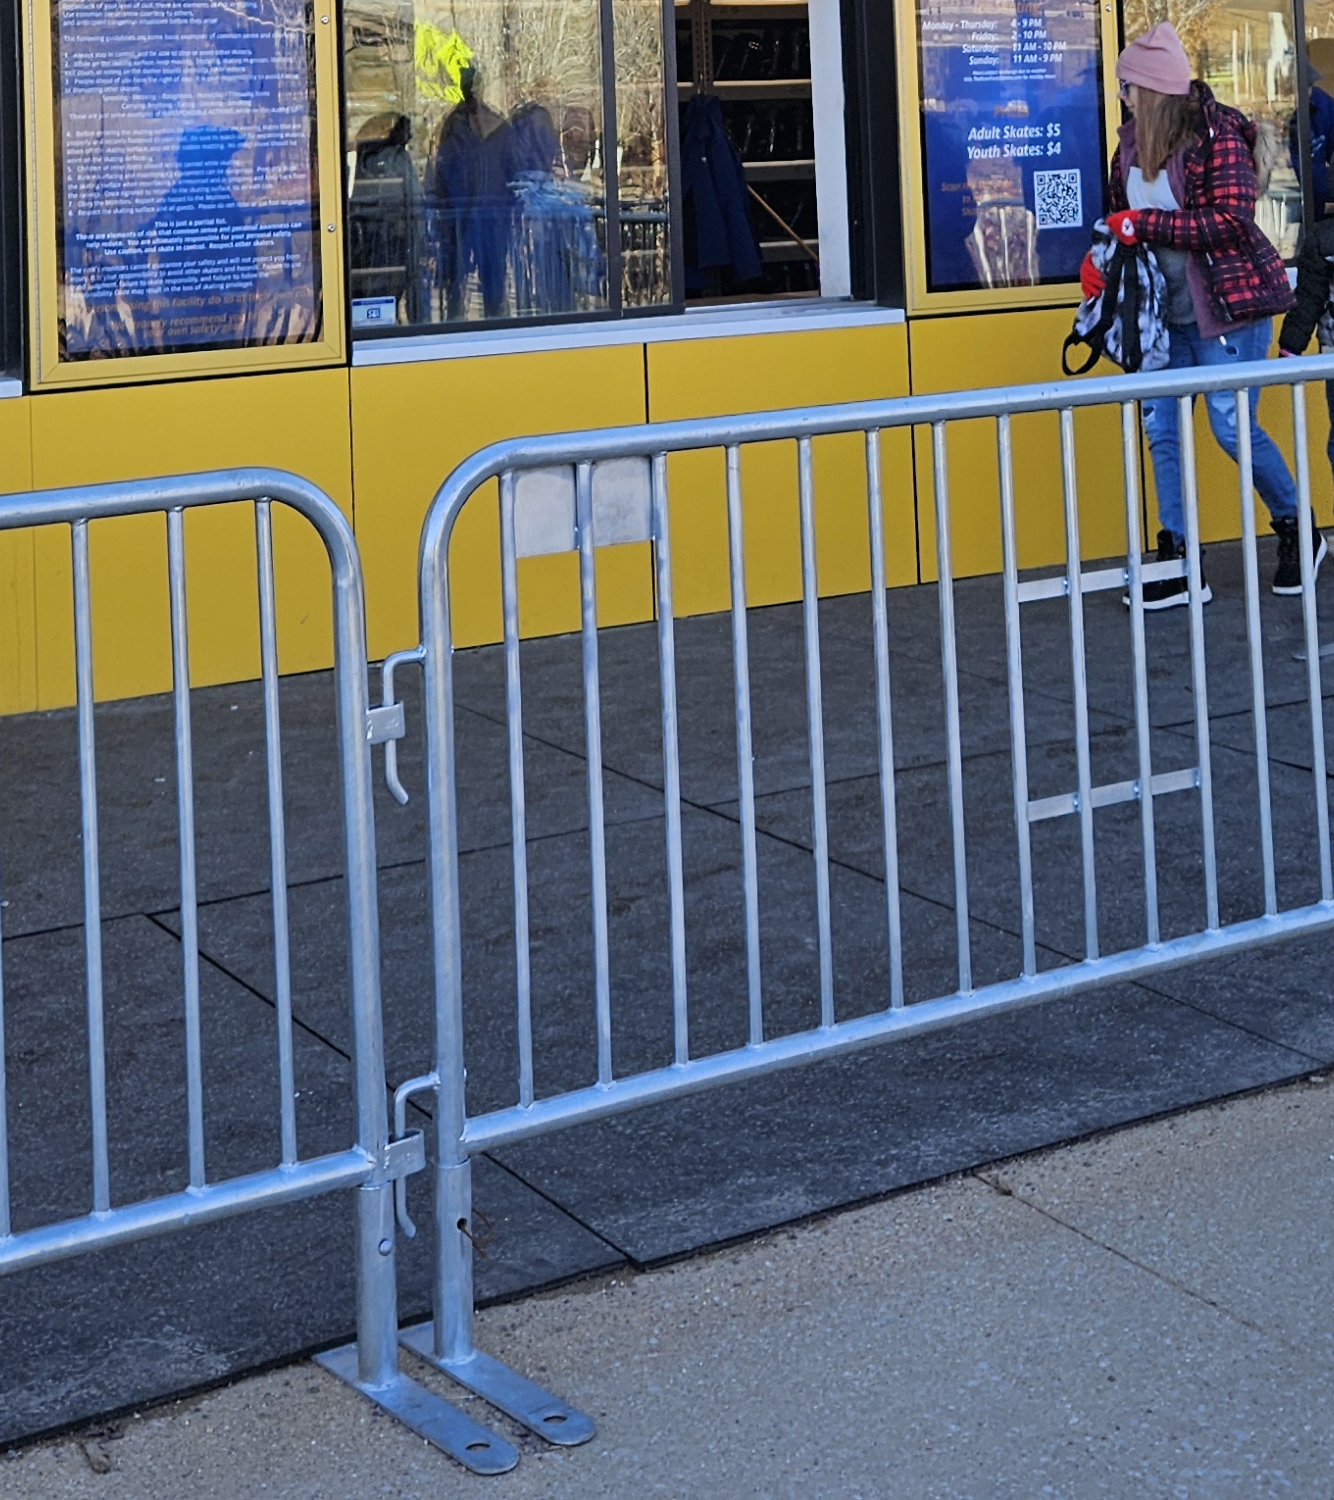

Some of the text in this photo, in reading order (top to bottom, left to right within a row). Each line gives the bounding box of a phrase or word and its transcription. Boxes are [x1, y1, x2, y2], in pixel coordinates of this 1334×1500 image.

[922, 21, 954, 31] Monday
[960, 20, 998, 30] Thursday:
[1010, 19, 1016, 27] 4
[1022, 19, 1028, 27] 9
[1029, 18, 1042, 27] PM
[971, 31, 999, 42] Friday:
[1011, 31, 1017, 39] 2
[1023, 31, 1033, 39] 10
[1033, 30, 1047, 38] PM
[962, 43, 999, 54] Saturday:
[1012, 43, 1021, 51] 11
[1022, 42, 1037, 51] AM
[1043, 42, 1052, 50] 10
[1053, 41, 1067, 50] PM
[969, 55, 999, 65] Sunday:
[1013, 55, 1022, 63] 11
[1023, 54, 1037, 63] AM
[1043, 54, 1048, 62] 9
[1049, 53, 1062, 62] PM
[968, 122, 1061, 141] Adult Skates: $5
[967, 141, 1061, 159] Youth Skates: $4
[194, 219, 215, 227] partial
[172, 296, 205, 309] facility
